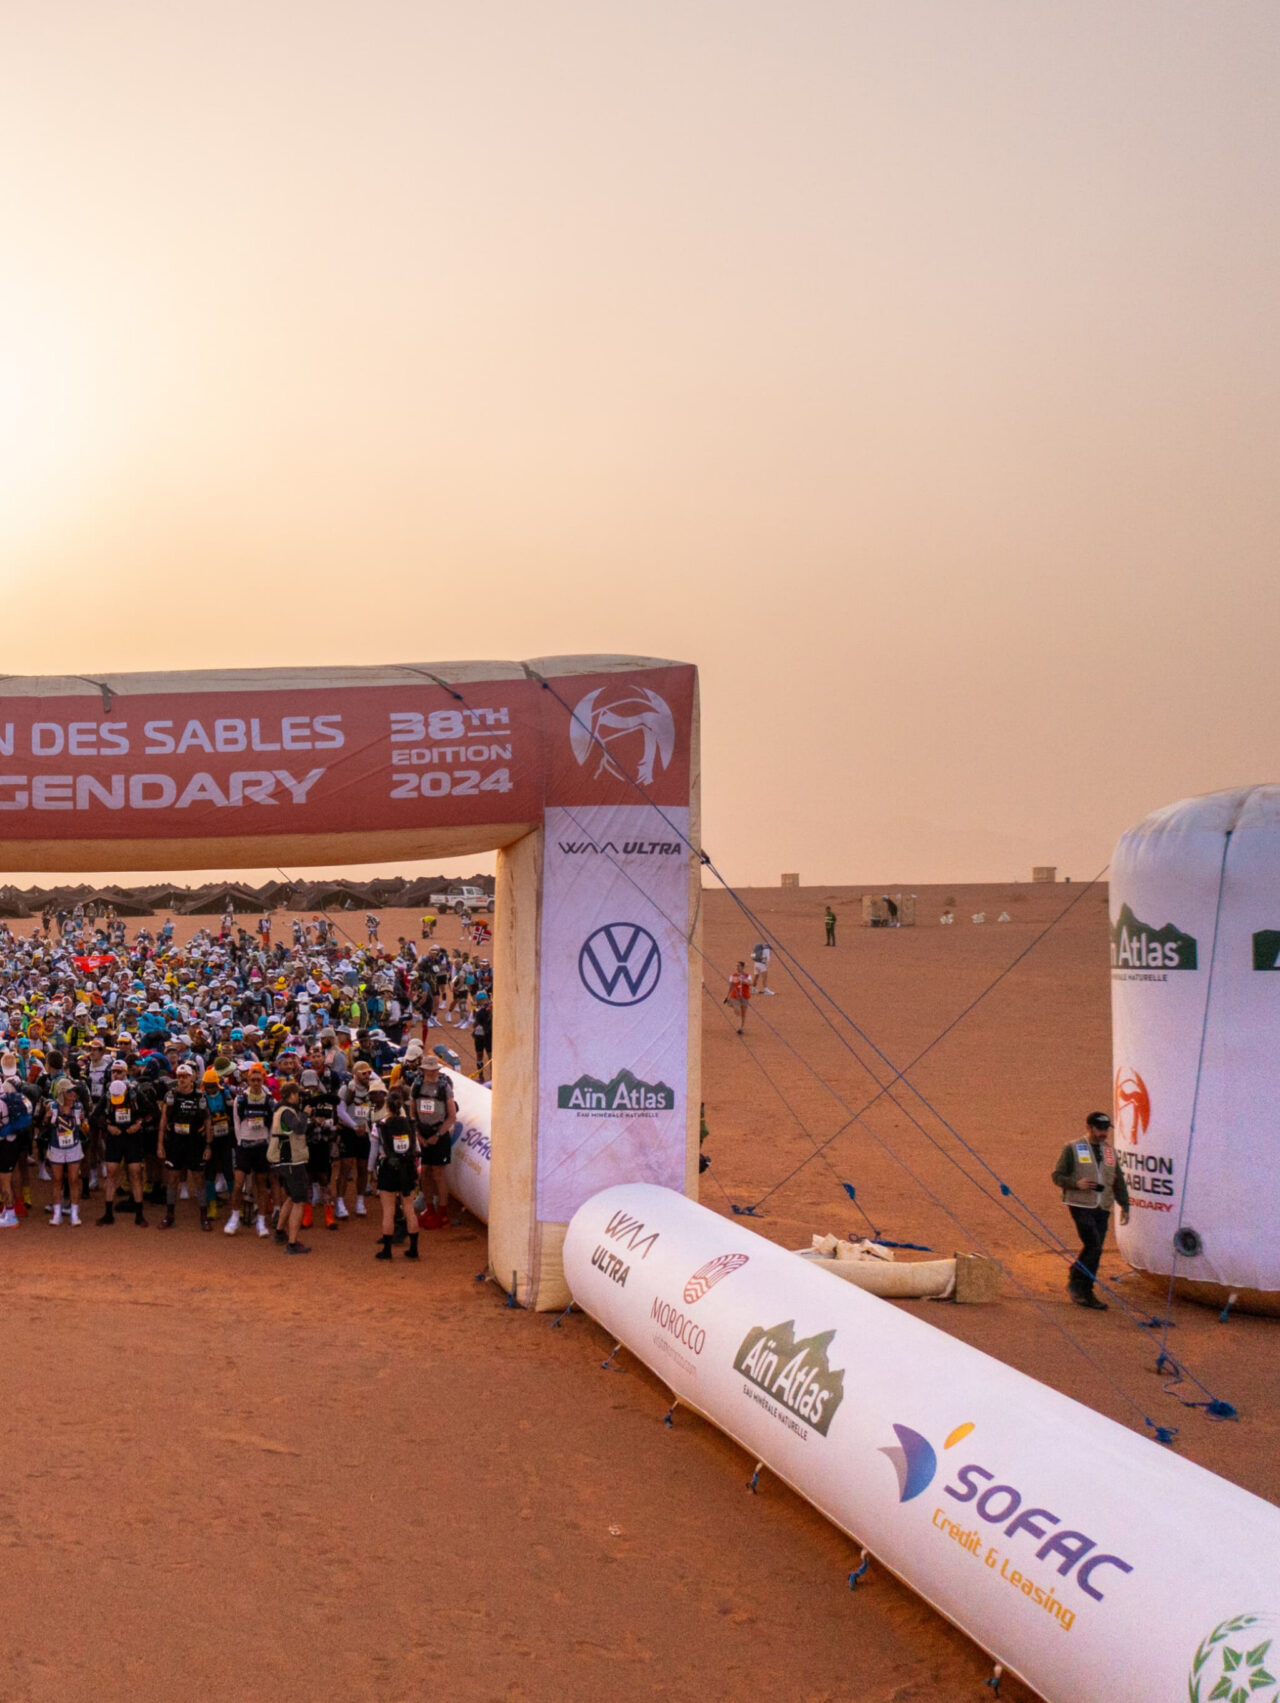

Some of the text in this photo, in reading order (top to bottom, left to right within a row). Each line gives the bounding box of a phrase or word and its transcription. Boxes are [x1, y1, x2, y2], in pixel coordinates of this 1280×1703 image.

[31, 721, 129, 757] DES
[144, 715, 346, 756] SABLES
[390, 707, 510, 742] 38TH
[391, 744, 513, 767] EDITION
[390, 768, 514, 800] 2024
[621, 842, 682, 855] ULTRA
[1118, 925, 1180, 967] Atlas
[568, 1082, 667, 1110] Aïn Atlas
[1125, 1173, 1174, 1196] ABLES
[591, 1244, 632, 1289] ULTRA
[650, 1295, 706, 1355] MOROCCO
[740, 1335, 780, 1388] Aïn
[771, 1346, 830, 1425] Atlas
[943, 1463, 1135, 1603] SOFAC
[984, 1547, 998, 1570] &
[999, 1558, 1077, 1632] Leasing
